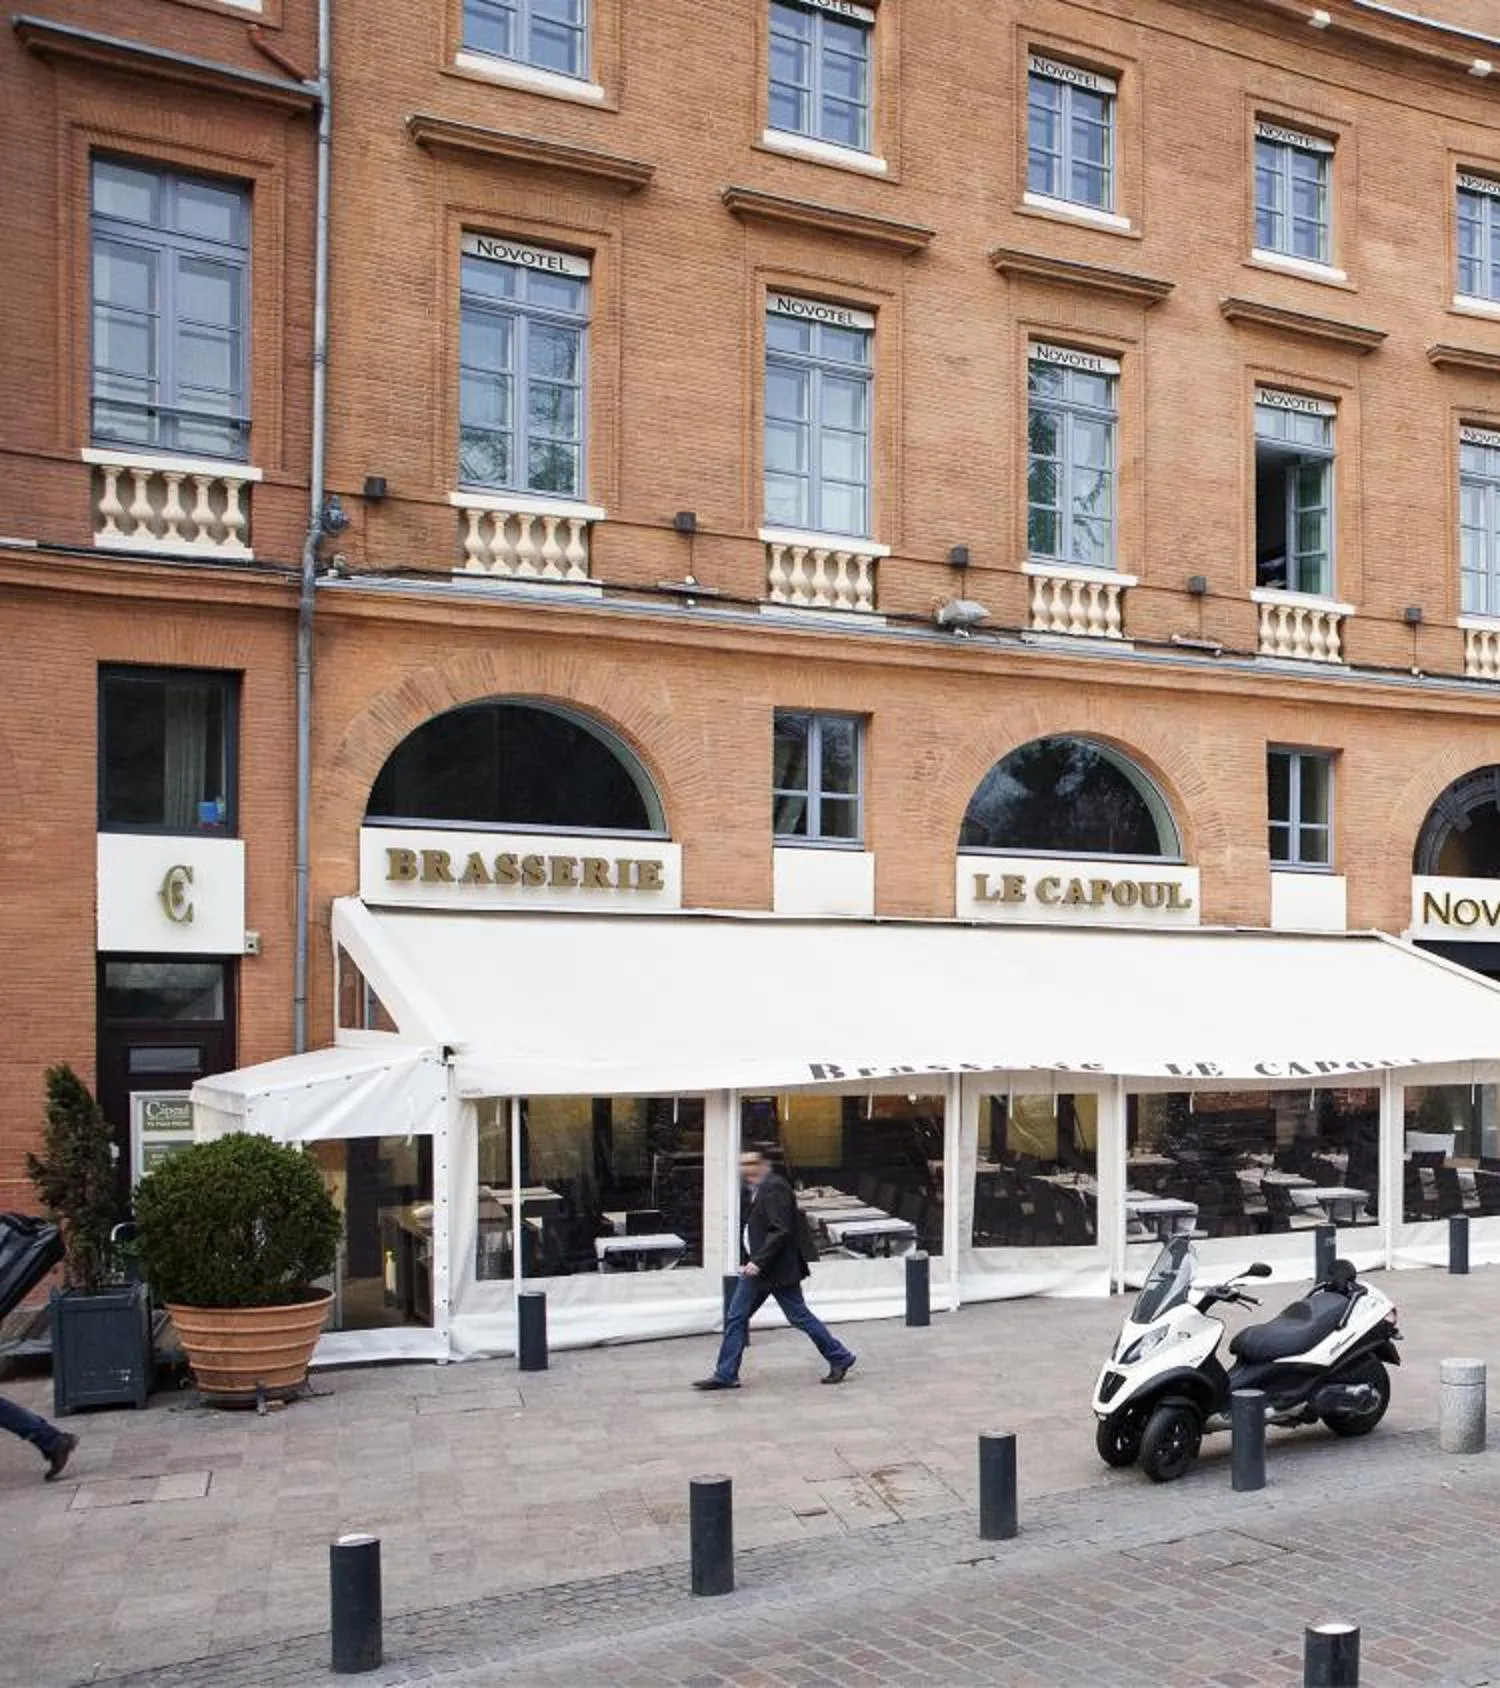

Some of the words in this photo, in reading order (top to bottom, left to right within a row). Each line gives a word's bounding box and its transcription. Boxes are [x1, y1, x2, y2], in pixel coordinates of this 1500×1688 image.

[1033, 57, 1099, 89] NOVOTEL
[1258, 123, 1317, 149] NOVOTEL
[476, 239, 571, 273] NOVOTEL
[777, 297, 858, 327] NOVOTEL
[1037, 345, 1105, 371] NOVOTEL
[1261, 390, 1322, 414] NOVOTEL
[385, 847, 665, 891] BRASSERIE
[973, 873, 1027, 903] LE
[1034, 877, 1193, 911] CAPOUL
